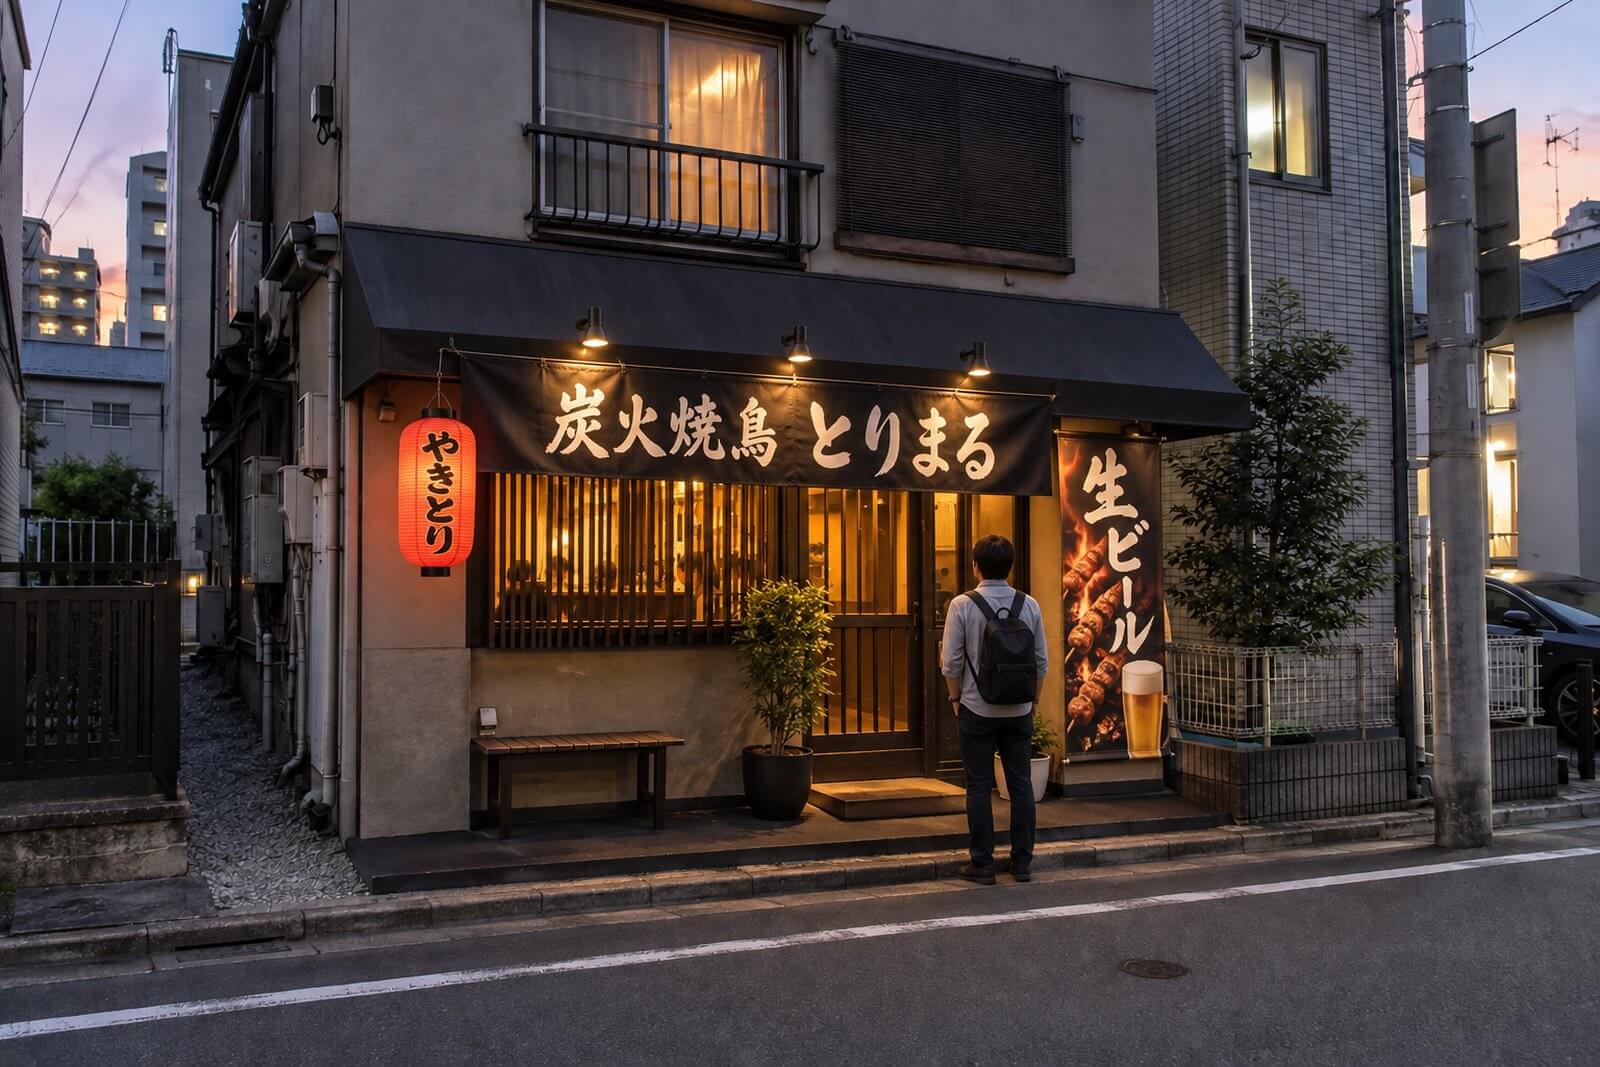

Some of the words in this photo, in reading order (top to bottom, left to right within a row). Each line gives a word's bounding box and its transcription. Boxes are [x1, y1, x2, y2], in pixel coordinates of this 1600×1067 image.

[422, 431, 459, 554] やきとり
[545, 383, 777, 467] 炭火焼鳥
[810, 401, 995, 480] とりまる
[1082, 447, 1155, 655] 生ビール
